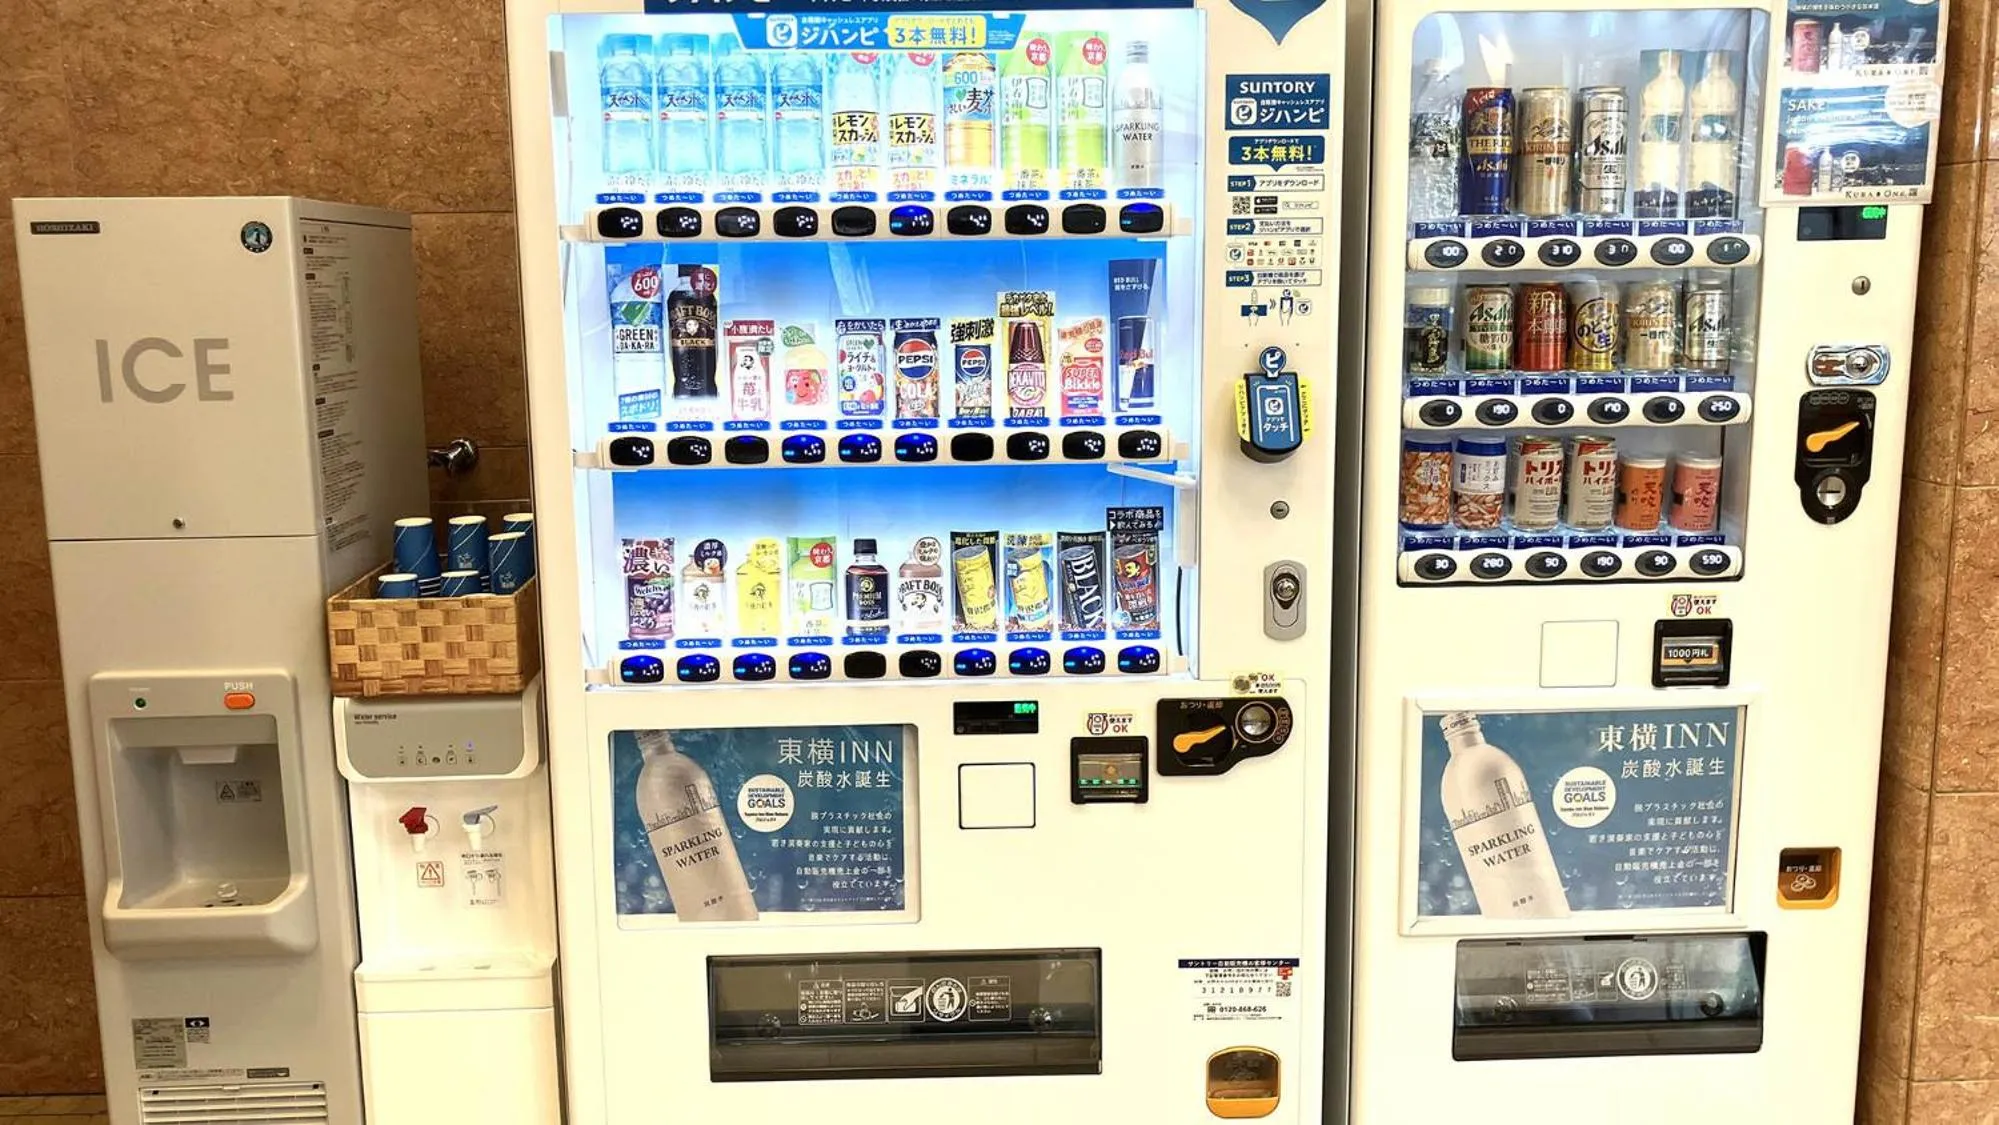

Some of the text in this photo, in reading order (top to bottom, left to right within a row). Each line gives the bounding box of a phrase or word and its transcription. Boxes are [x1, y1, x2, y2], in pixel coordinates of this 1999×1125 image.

[801, 27, 879, 46] ジハンピ
[895, 26, 976, 45] 3本無料!
[954, 71, 978, 84] 600
[1240, 81, 1315, 94] SUNTORY
[1788, 100, 1827, 111] SAKE
[838, 114, 870, 127] レモン
[1260, 107, 1325, 123] ジハンピ
[895, 116, 926, 129] レモン
[839, 129, 877, 143] スカッシュ
[896, 130, 934, 144] スカッシュ
[1122, 133, 1153, 141] WATER
[1469, 139, 1489, 147] THE
[1241, 145, 1312, 162] 3本無料!
[634, 277, 659, 291] 600
[619, 328, 654, 341] GREEN
[950, 318, 995, 343] 強刺激
[1597, 332, 1611, 347] 生
[899, 354, 933, 364] PEPSI
[1265, 351, 1281, 368] ピ
[96, 336, 235, 404] ICE
[1067, 368, 1098, 378] SUPER
[1263, 422, 1289, 432] タッチ
[1108, 510, 1162, 519] コラボ商品を
[1696, 605, 1712, 615] OK
[1668, 647, 1709, 658] 1000円札
[224, 682, 253, 690] PUSH
[1113, 724, 1128, 733] OK
[1598, 722, 1730, 752] 東横INN
[777, 737, 893, 765] 東横INN
[1621, 757, 1725, 779] 炭酸水誕生
[797, 770, 892, 788] 炭酸水誕生
[747, 798, 786, 808] GOALS
[1564, 792, 1606, 803] GOALS
[1634, 800, 1724, 813] 脱プラスチック社会の
[811, 811, 892, 820] 脱プラスチック社会の
[823, 825, 892, 834] 実現に貢献します。
[661, 827, 723, 858] SPARKLING
[1468, 823, 1535, 857] SPARKLING
[675, 846, 721, 869] WATER
[1482, 843, 1532, 869] WATER
